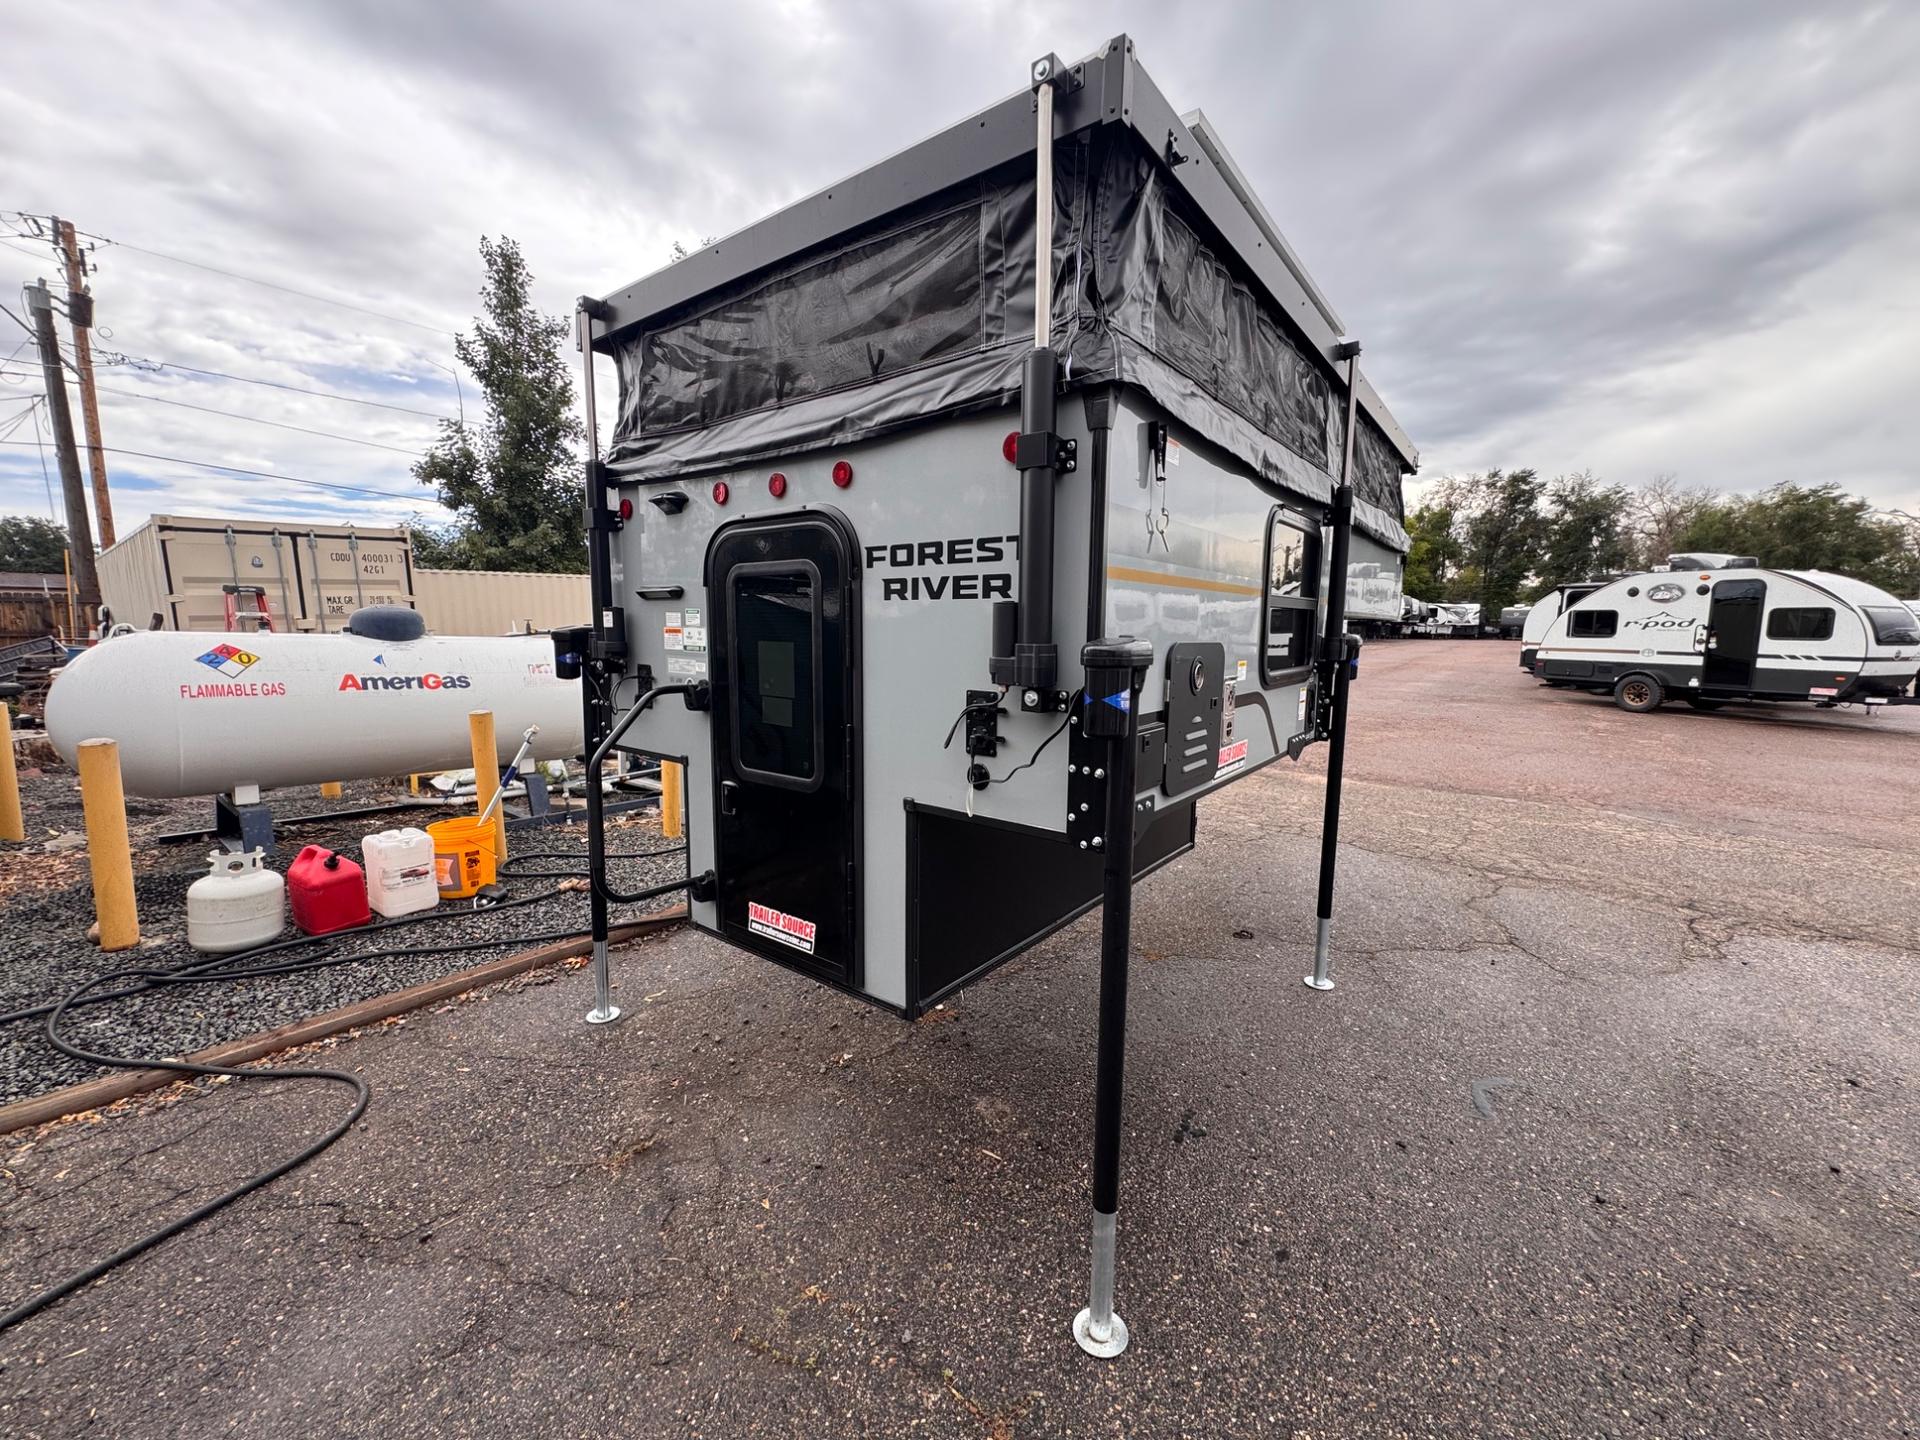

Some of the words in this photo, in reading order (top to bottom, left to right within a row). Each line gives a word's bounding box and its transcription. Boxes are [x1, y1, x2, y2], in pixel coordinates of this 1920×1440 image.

[882, 573, 1012, 601] RIVER
[328, 605, 344, 614] TARE
[205, 652, 221, 666] 2
[237, 652, 252, 665] 0
[180, 683, 259, 699] FLAMMABLE
[260, 682, 286, 696] GAS
[339, 673, 471, 691] AmeriGas
[750, 904, 781, 927] TRAILER
[782, 915, 814, 939] SOURCE
